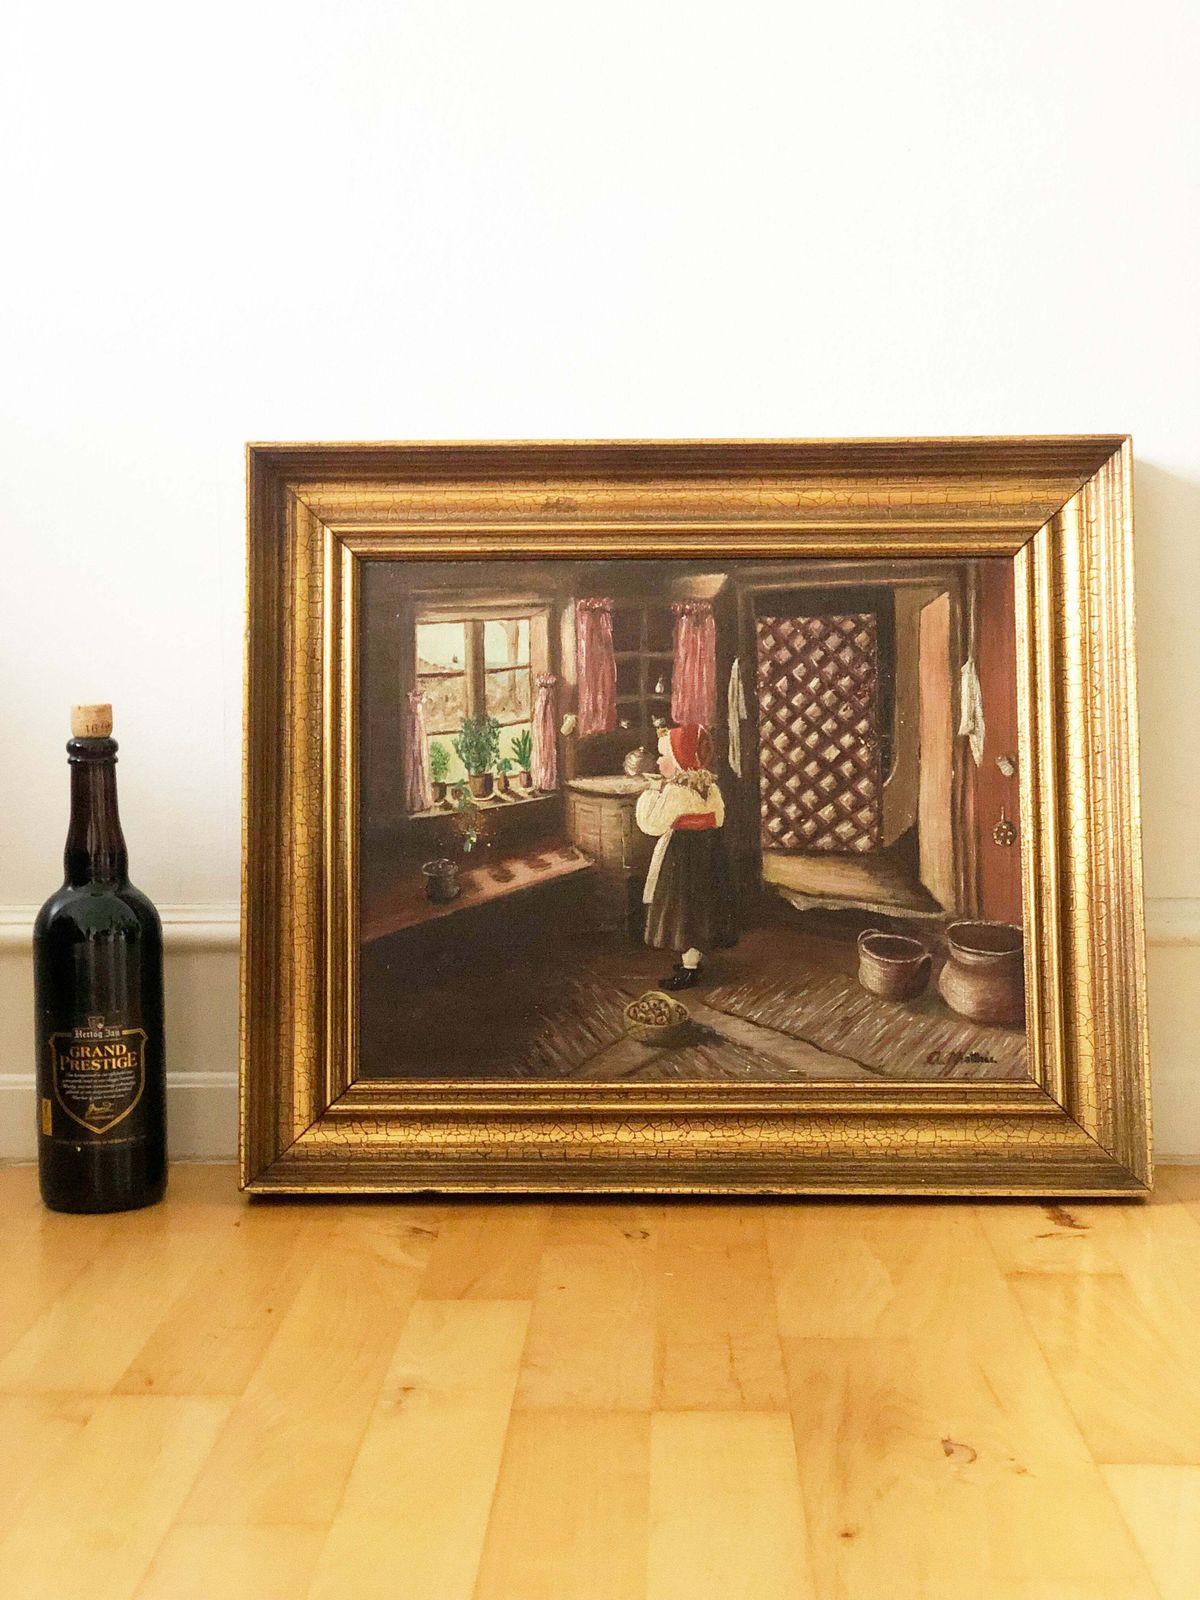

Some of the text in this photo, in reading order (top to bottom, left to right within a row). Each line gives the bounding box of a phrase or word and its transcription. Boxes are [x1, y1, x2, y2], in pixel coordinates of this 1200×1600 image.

[74, 1028, 120, 1039] Hertog Jan
[70, 1044, 127, 1058] GRAND
[60, 1052, 137, 1071] PRESTIGE
